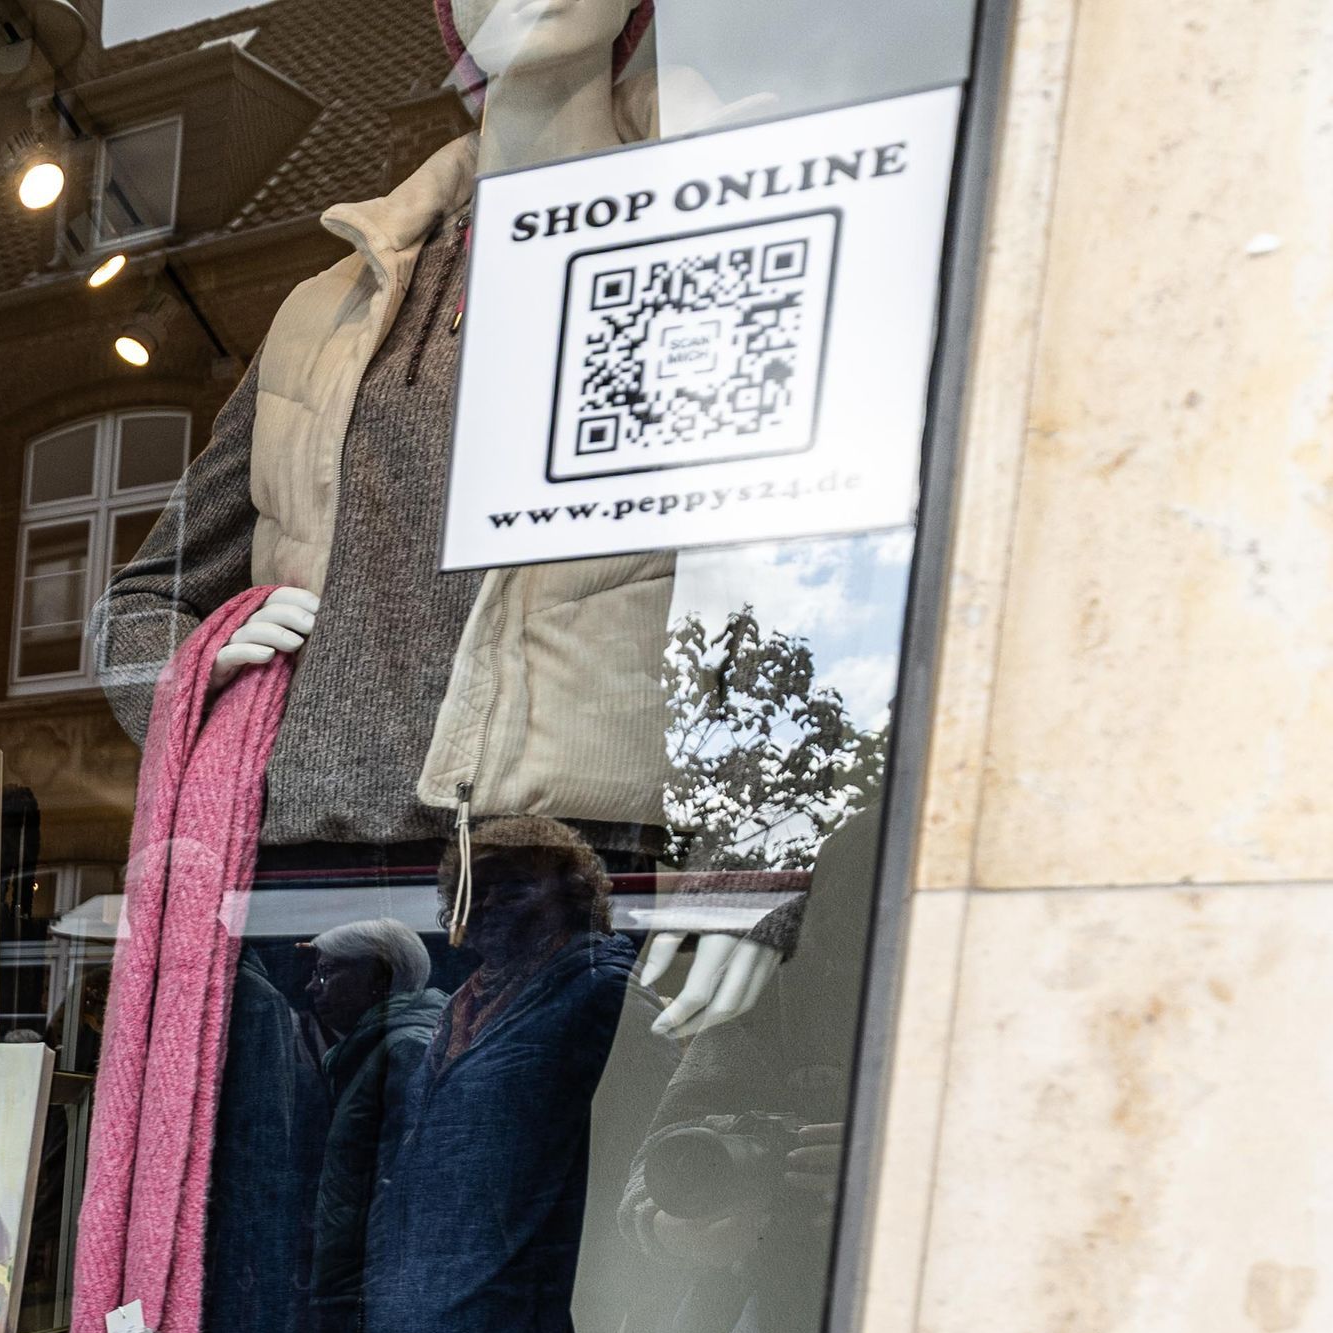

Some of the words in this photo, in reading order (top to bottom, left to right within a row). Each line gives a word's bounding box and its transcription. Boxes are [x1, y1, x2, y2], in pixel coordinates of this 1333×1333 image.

[510, 187, 656, 243] SHOP
[674, 141, 909, 214] ONLINE
[667, 349, 709, 364] MICH
[669, 336, 710, 350] SCAN
[488, 468, 863, 529] www.peppys24.de
